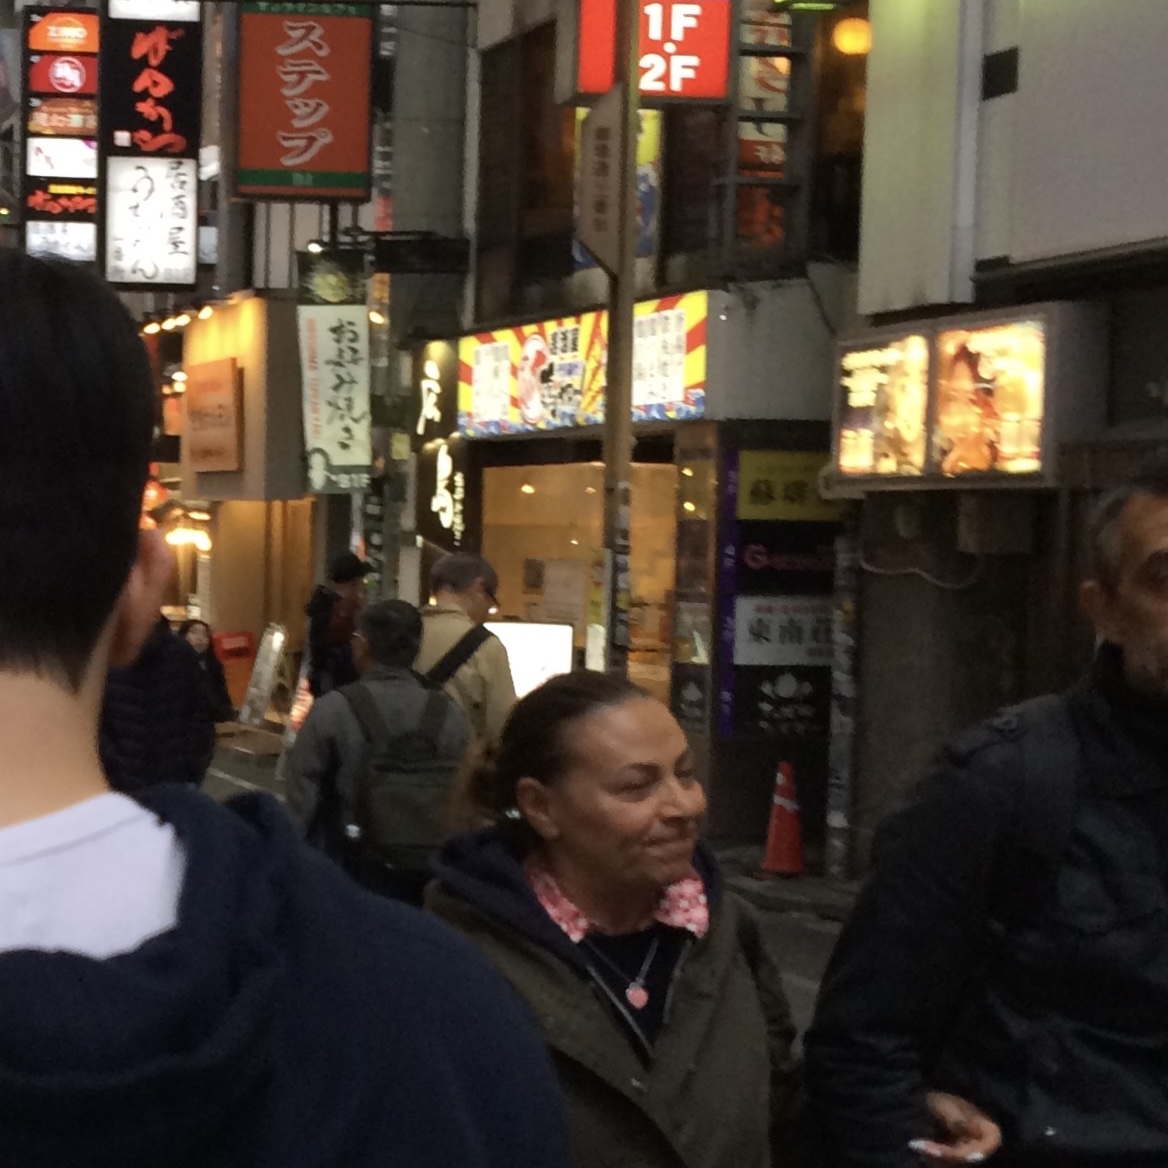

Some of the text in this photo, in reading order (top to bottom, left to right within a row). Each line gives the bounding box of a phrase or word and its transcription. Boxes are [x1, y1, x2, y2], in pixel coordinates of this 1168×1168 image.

[643, 3, 703, 41] 1F
[637, 53, 701, 92] 2F
[274, 20, 334, 167] ステップ
